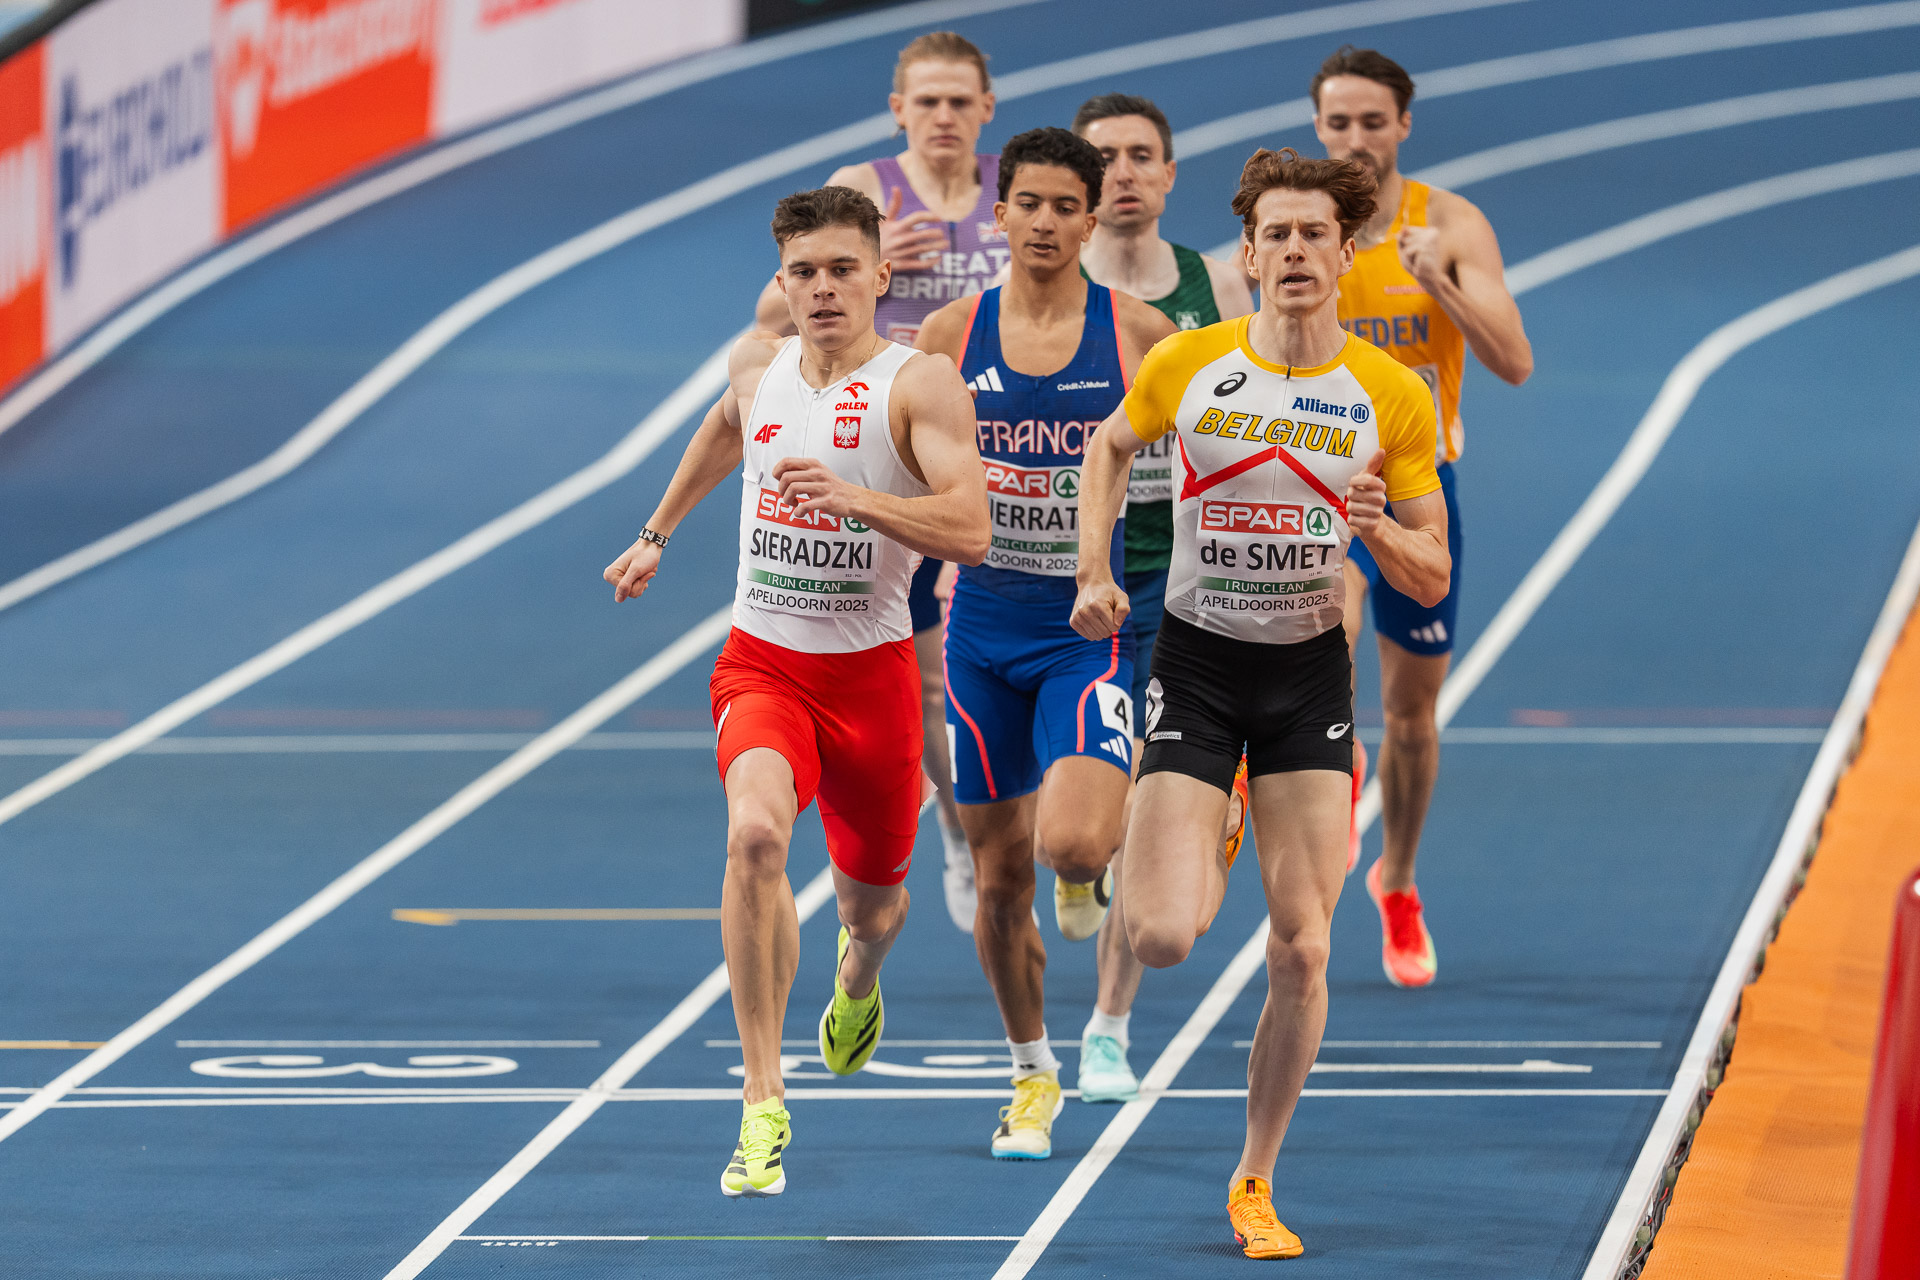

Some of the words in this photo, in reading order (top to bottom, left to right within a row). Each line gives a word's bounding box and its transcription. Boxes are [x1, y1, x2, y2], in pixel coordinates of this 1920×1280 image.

[919, 248, 1010, 275] EAT
[1340, 314, 1429, 348] EDEN
[1057, 382, 1078, 391] Crédit
[1086, 380, 1110, 389] Mutuel
[835, 402, 869, 411] ORLEN
[1292, 397, 1347, 418] Allianz
[753, 424, 783, 444] 4F
[976, 419, 1103, 456] FRANCE
[1193, 406, 1357, 459] BELGIUM
[983, 466, 1048, 495] PAR
[1204, 505, 1301, 531] SPAR
[750, 527, 873, 570] SIERADZKI
[1200, 539, 1237, 568] de
[1246, 543, 1336, 571] SMET
[1046, 558, 1077, 571] 2025
[767, 574, 771, 584] I
[772, 577, 796, 589] RUN
[1225, 580, 1230, 591] I
[1231, 581, 1260, 593] RUN
[747, 587, 831, 611] APELDOORN
[834, 599, 870, 612] 2025
[1201, 594, 1295, 612] APELDOORN
[1298, 593, 1330, 610] 2025
[1114, 697, 1129, 731] 4
